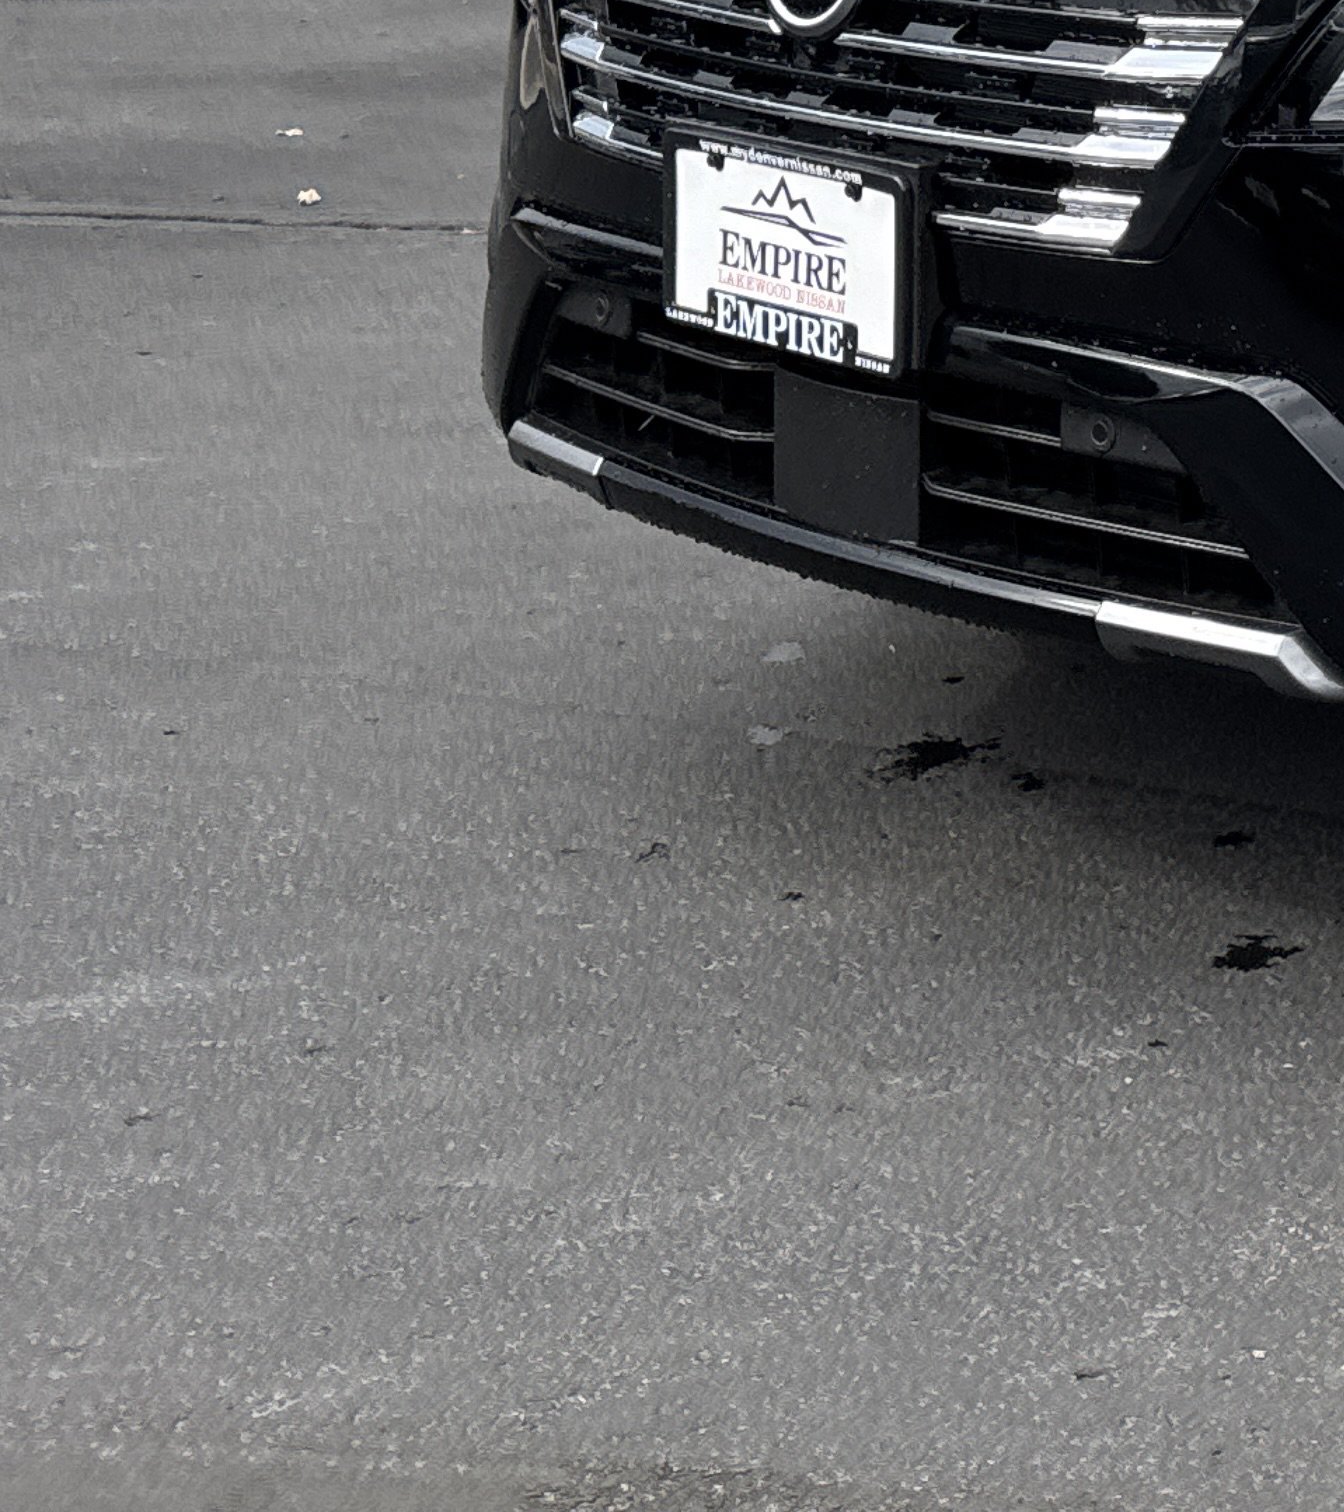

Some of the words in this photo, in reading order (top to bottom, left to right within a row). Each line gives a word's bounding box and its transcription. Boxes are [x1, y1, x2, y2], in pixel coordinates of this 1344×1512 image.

[717, 268, 792, 300] LAKEWOOD
[796, 288, 846, 315] NISSAN
[718, 228, 847, 296] EMPIRE
[714, 291, 844, 363] EMPIRE
